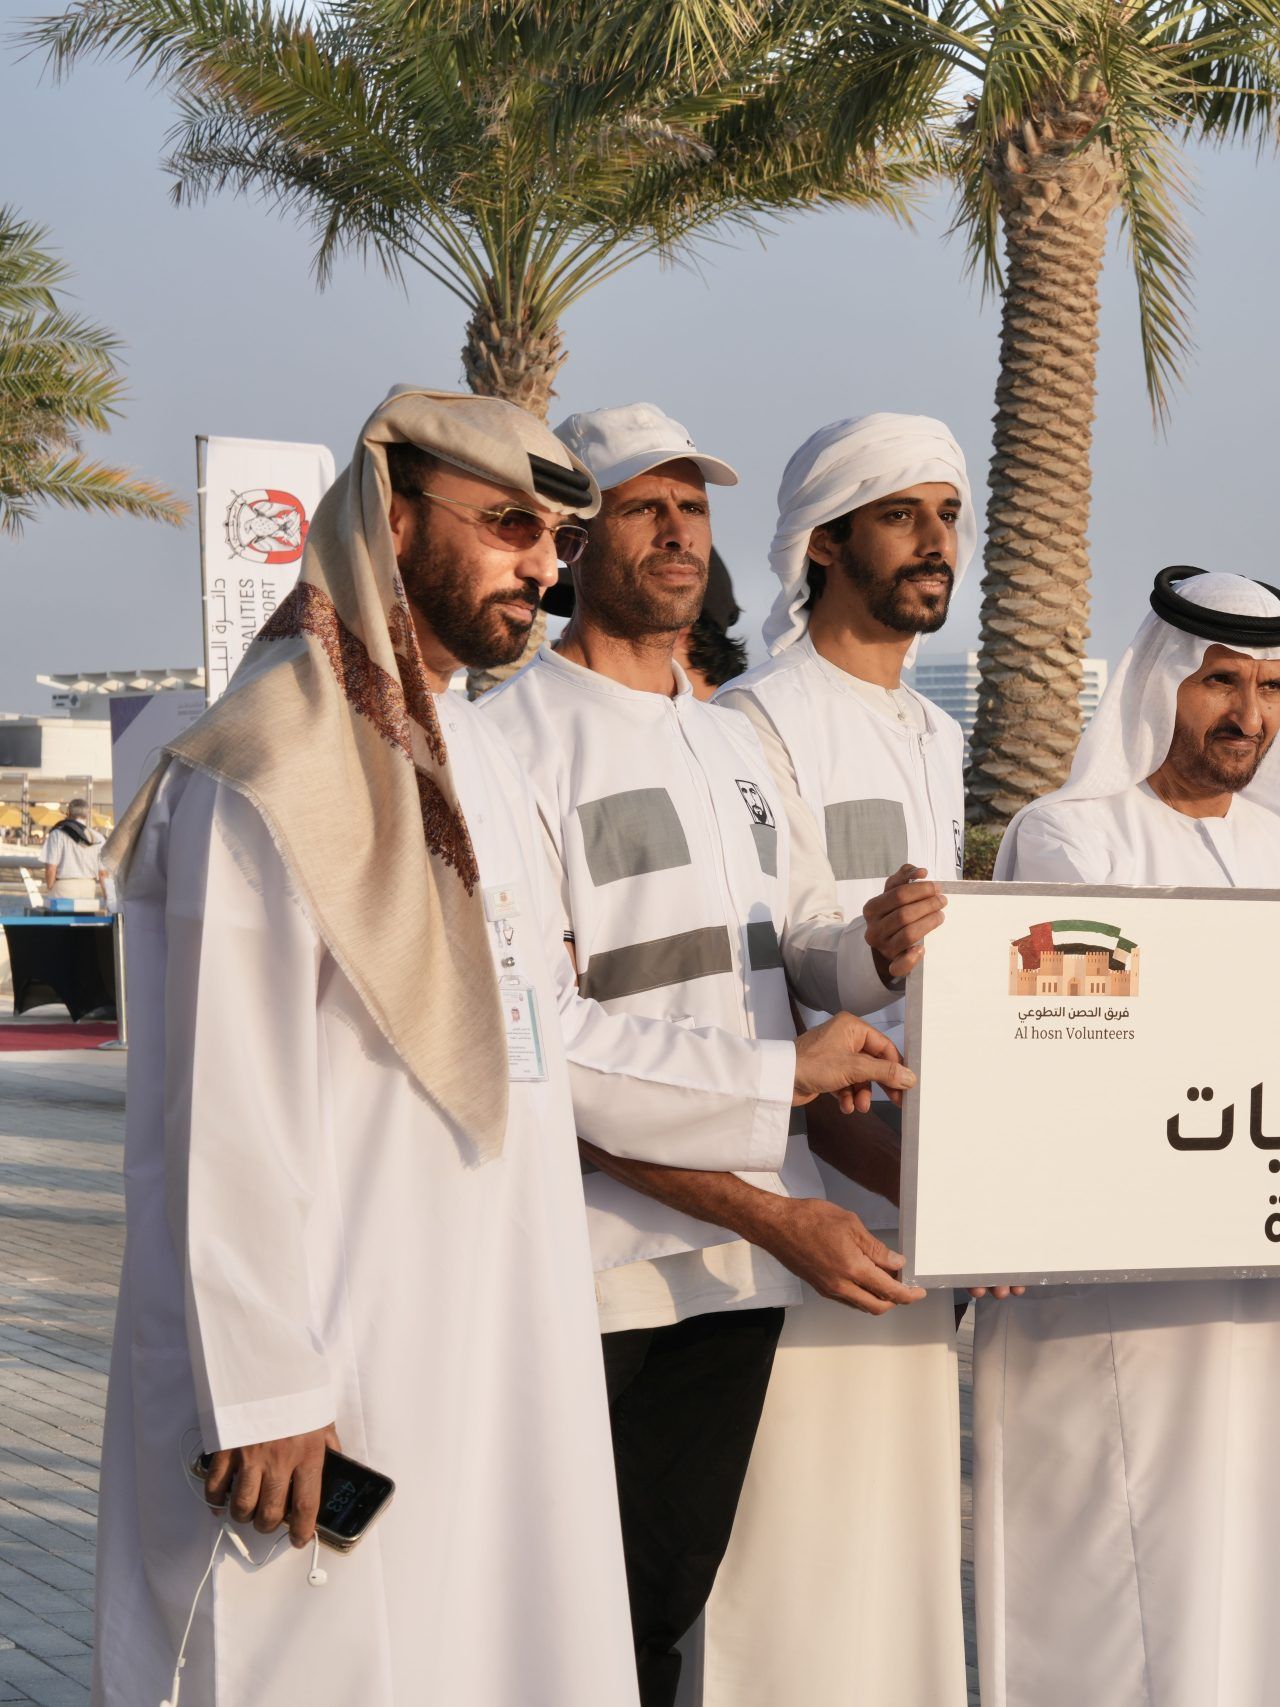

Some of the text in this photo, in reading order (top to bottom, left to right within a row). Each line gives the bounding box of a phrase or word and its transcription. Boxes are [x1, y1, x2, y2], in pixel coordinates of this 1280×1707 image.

[239, 578, 257, 651] PALITIES
[1019, 1007, 1129, 1023] فريق الحصن التطوعي
[1015, 1026, 1134, 1039] Al hosn Volunteers
